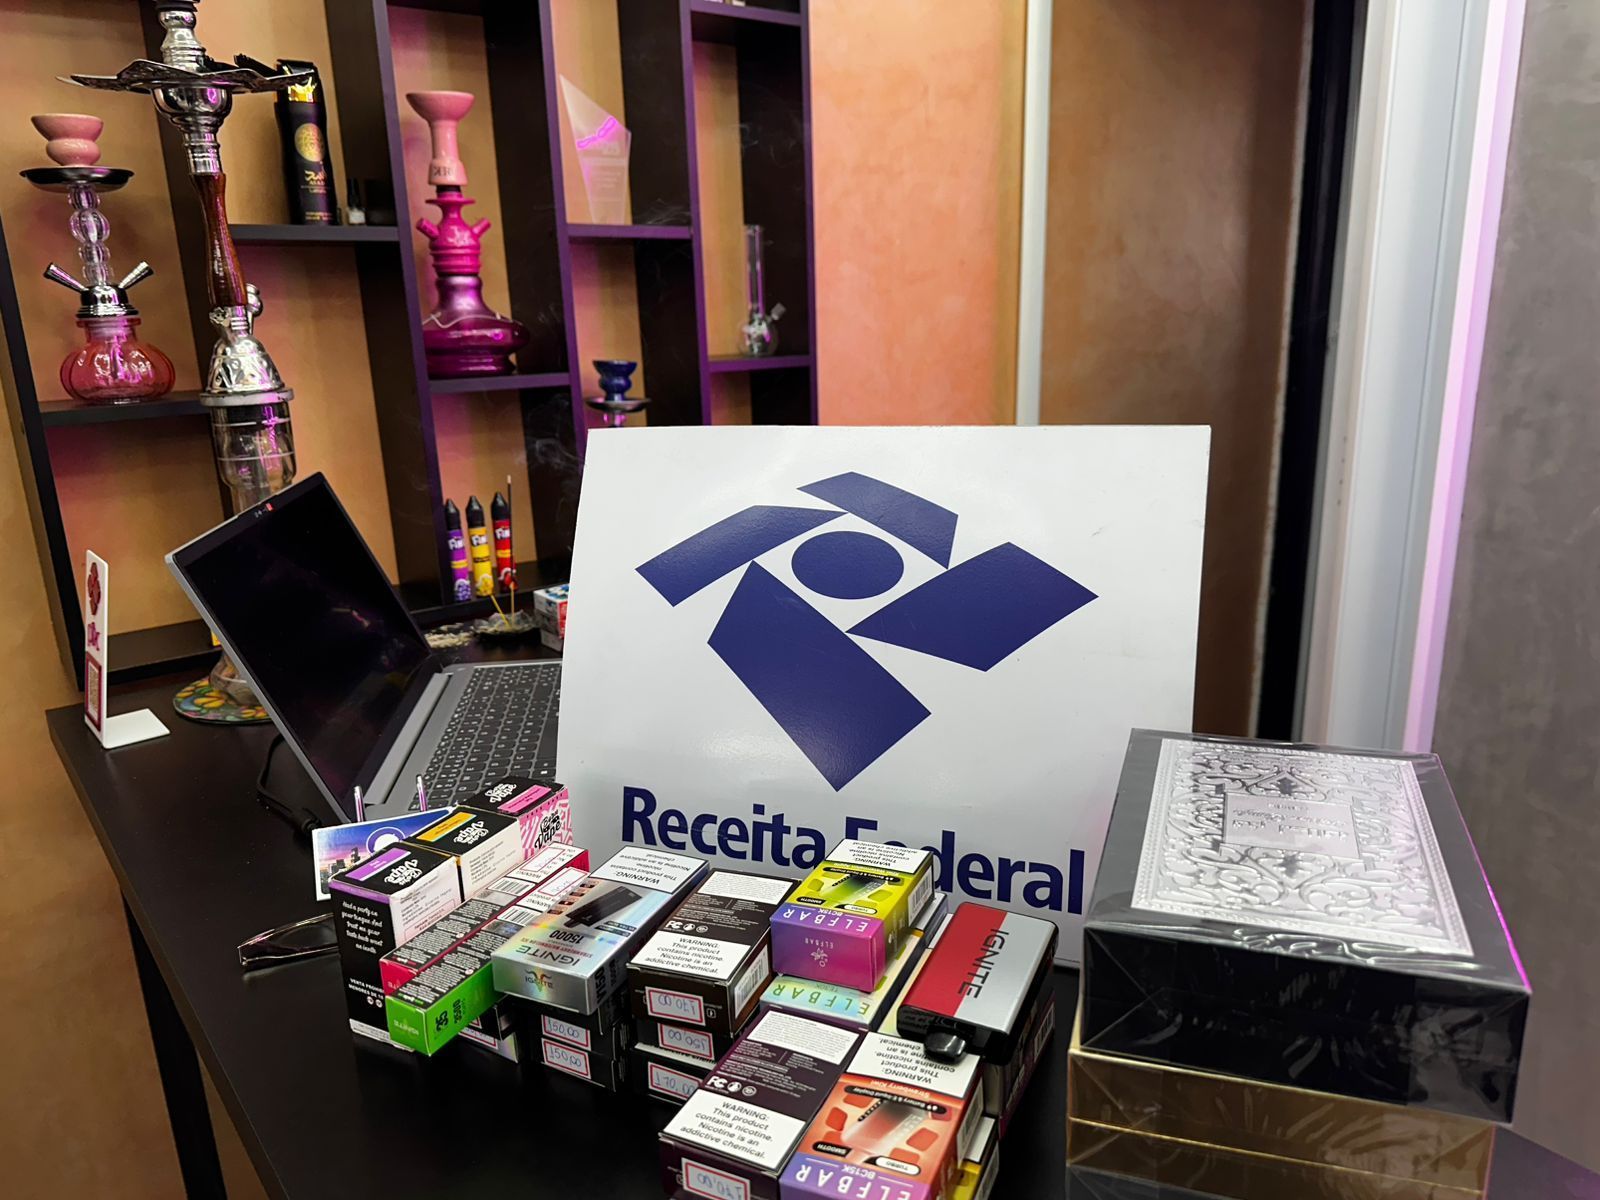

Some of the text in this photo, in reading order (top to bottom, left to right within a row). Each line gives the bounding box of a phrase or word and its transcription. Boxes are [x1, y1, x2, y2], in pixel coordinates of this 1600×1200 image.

[453, 821, 484, 843] Vape
[535, 818, 562, 850] Vape
[622, 786, 826, 869] Receita
[845, 816, 1085, 915] deral
[384, 859, 418, 883] Vape
[615, 871, 660, 884] WARNING:
[782, 908, 869, 932] ELFBAR
[549, 930, 584, 944] 15000
[680, 937, 720, 949] WARNING:
[805, 937, 834, 949] ELFBAR
[516, 945, 580, 967] IGNITE
[657, 946, 690, 957] contains
[672, 942, 721, 955] This product
[645, 957, 680, 968] addictive
[660, 952, 693, 963] Nicotine
[958, 928, 1010, 999] IGNITE
[525, 975, 553, 988] IGNITE
[773, 984, 870, 1015] ELFBAR
[881, 1060, 940, 1078] This product
[915, 1060, 956, 1073] contains
[882, 1068, 932, 1084] WARNING:
[889, 1082, 930, 1099] Strawberry
[903, 1096, 926, 1108] Battery
[713, 1108, 769, 1131] This product
[722, 1101, 769, 1121] WARNING:
[695, 1112, 773, 1142] contains nicotine.
[699, 1122, 736, 1138] Nicotine
[747, 1138, 760, 1147] an
[680, 1126, 766, 1159] addictive chemical.
[817, 1144, 847, 1155] SMOOTH
[841, 1164, 877, 1180] BC15K
